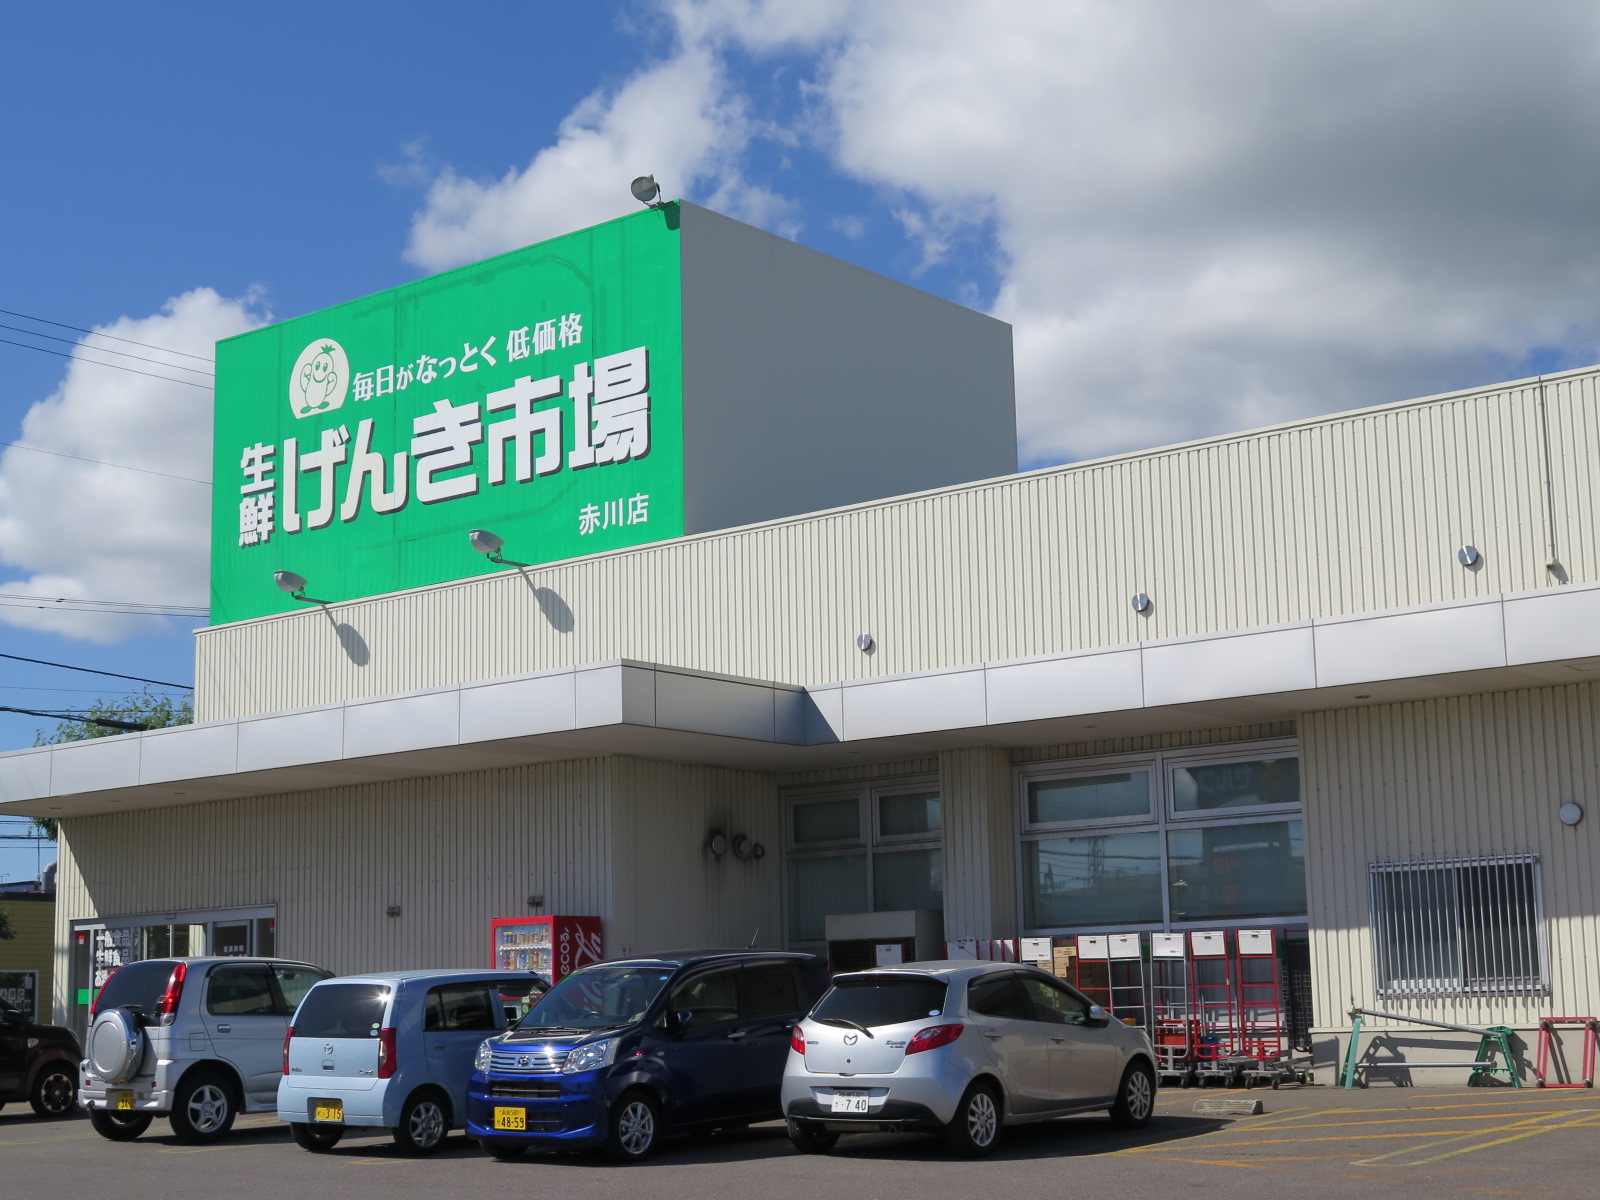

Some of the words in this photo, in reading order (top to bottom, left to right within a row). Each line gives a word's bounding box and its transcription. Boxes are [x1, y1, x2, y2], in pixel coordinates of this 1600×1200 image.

[352, 335, 497, 401] 毎日がなっとく
[506, 312, 583, 363] 低価格
[282, 345, 650, 534] げんき市場
[239, 441, 276, 549] 生鮮
[578, 492, 650, 536] 赤川店
[501, 1116, 524, 1129] 48-59
